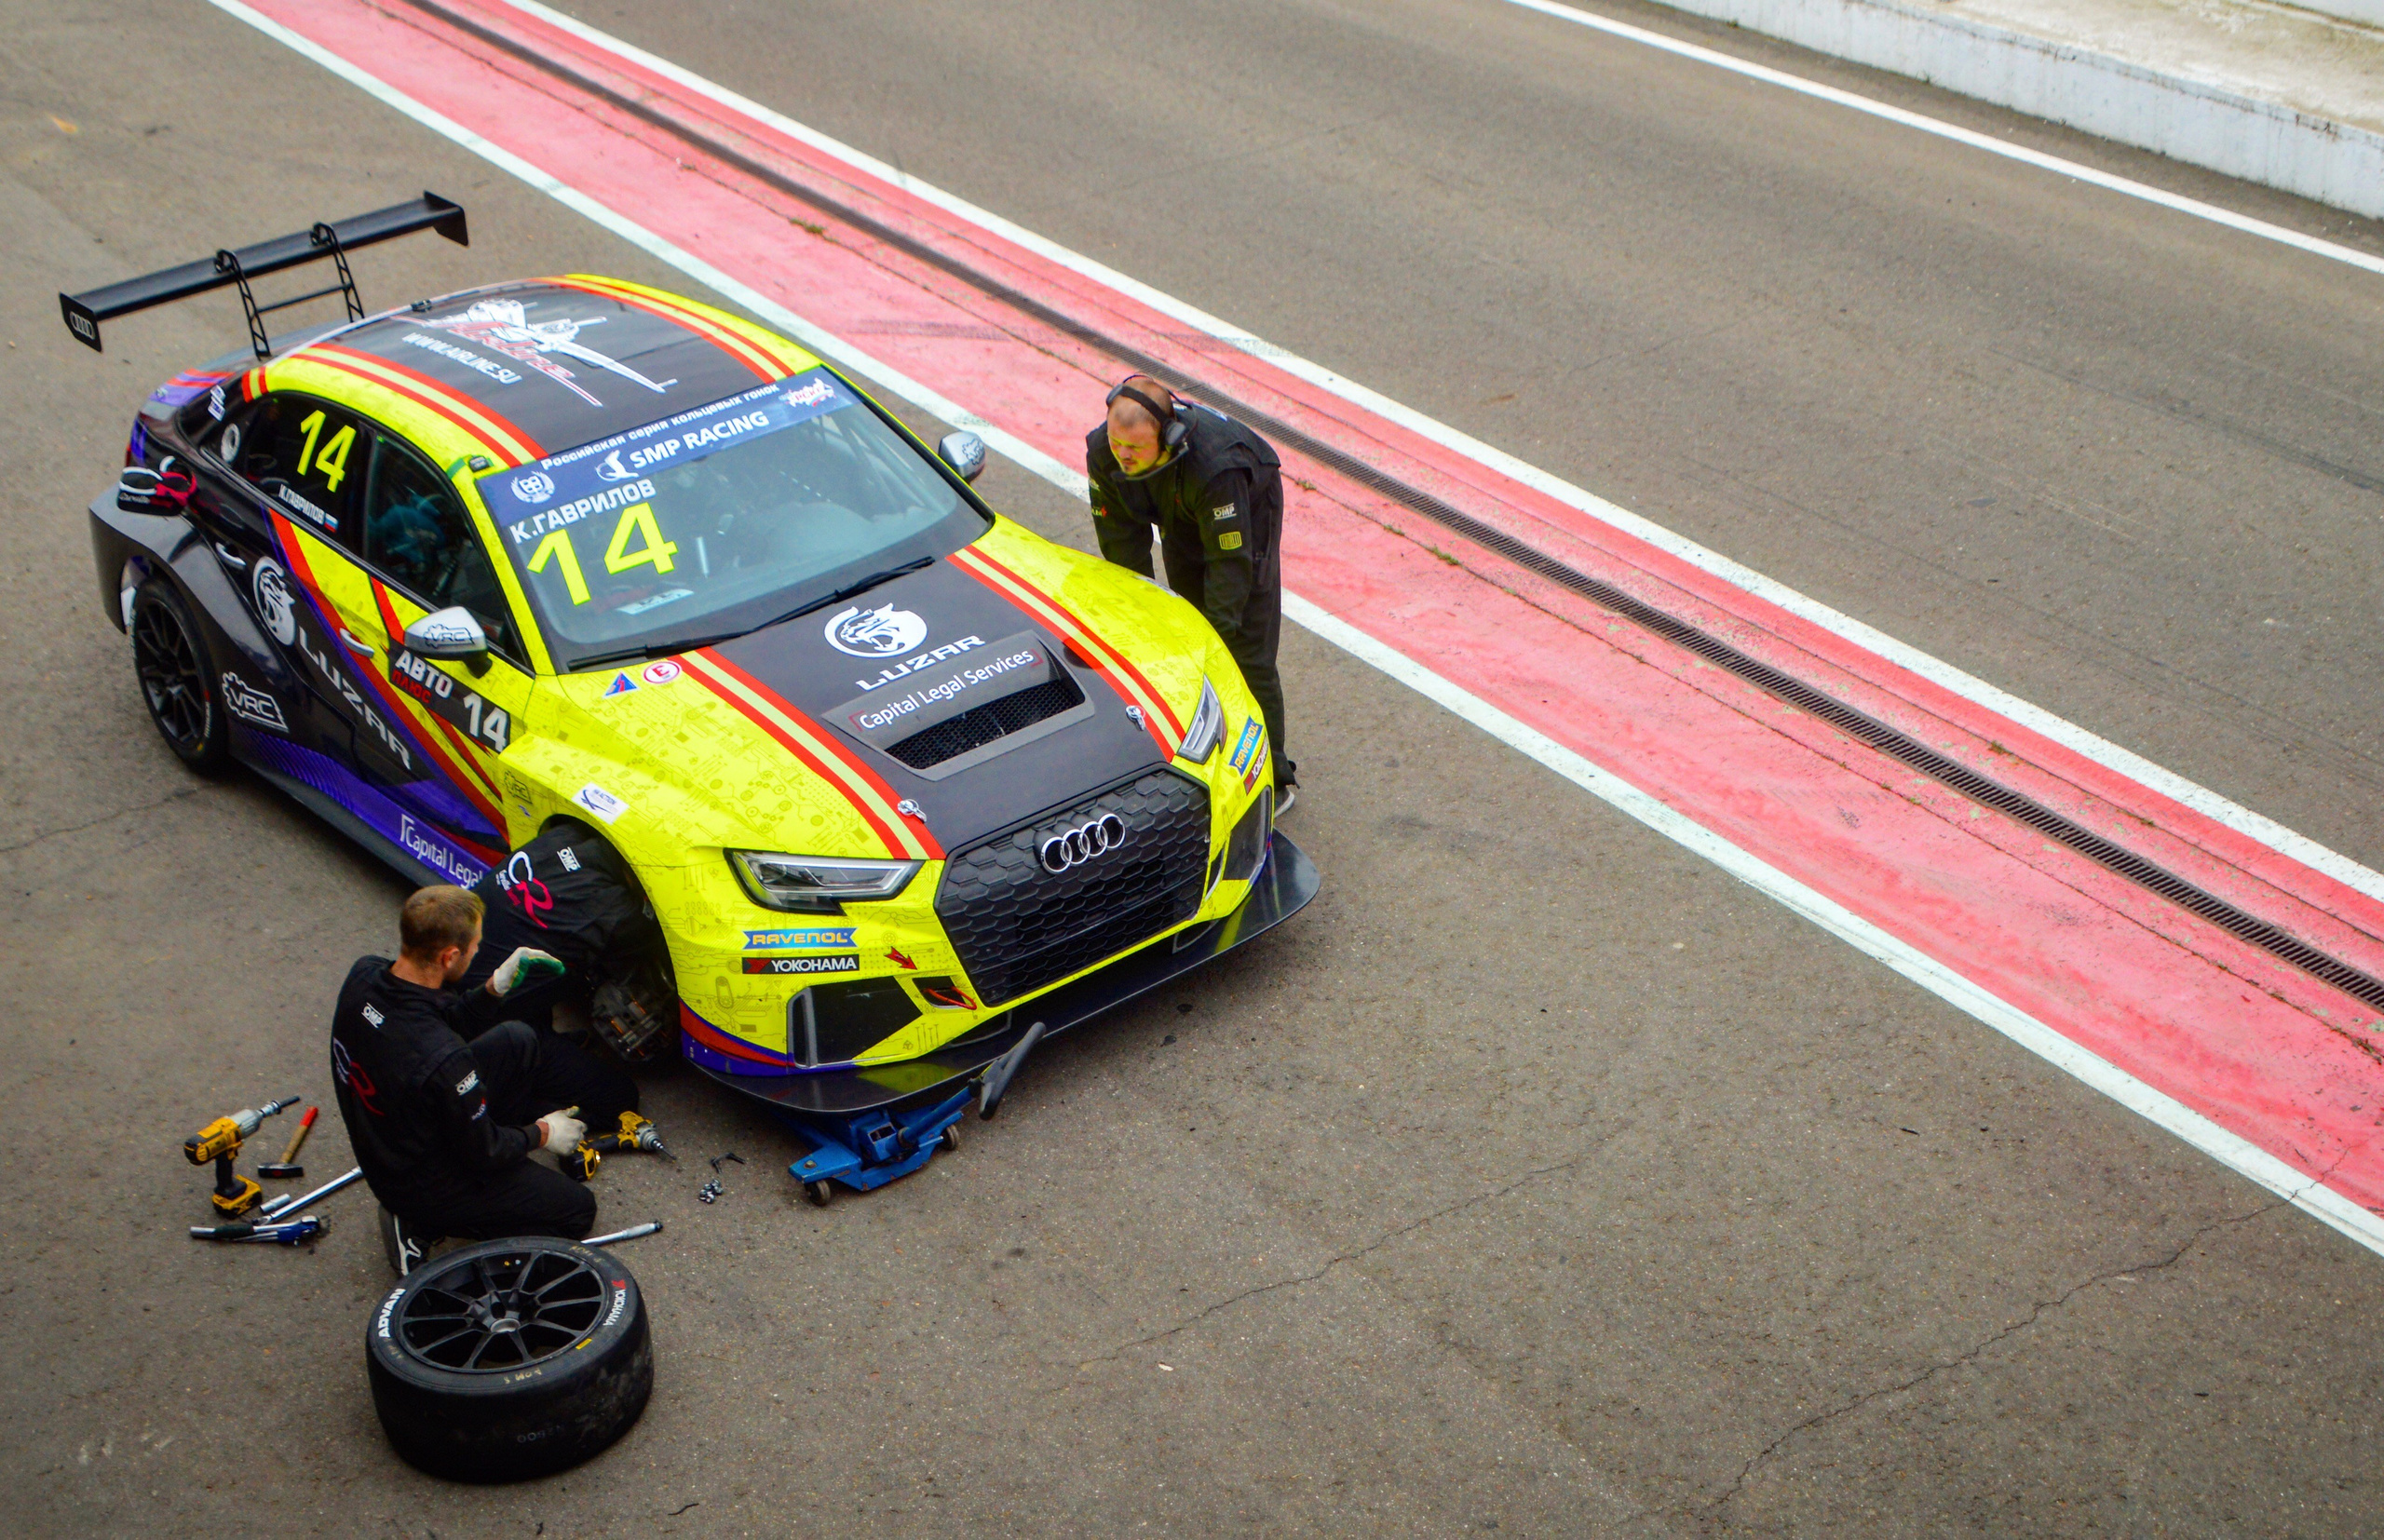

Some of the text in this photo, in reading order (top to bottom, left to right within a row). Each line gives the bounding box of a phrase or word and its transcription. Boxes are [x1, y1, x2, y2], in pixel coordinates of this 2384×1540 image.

[540, 384, 780, 470] Российская серия кольцевых гонок
[630, 411, 770, 469] SMP RACING
[297, 410, 357, 493] 14
[509, 478, 657, 545] К.ГАВРИЛОВ
[1213, 506, 1235, 518] OMP
[527, 502, 678, 606] 14
[430, 632, 467, 642] VRC
[395, 649, 454, 699] АВТО
[652, 665, 670, 678] E
[855, 635, 986, 692] LUZAR
[230, 687, 275, 718] VRC
[298, 625, 412, 771] LUZAR
[391, 669, 431, 704] ПЛЮС
[859, 650, 1035, 729] Capital Legal Services
[463, 692, 508, 753] 14
[1234, 724, 1259, 769] RAVENOL
[405, 825, 447, 870] Capital
[559, 847, 579, 872] OMP
[752, 932, 848, 946] RAVENOL
[771, 957, 858, 973] YOKOHAMA
[362, 1005, 385, 1025] OMP
[455, 1072, 479, 1095] OMP
[377, 1288, 406, 1338] ADVAN
[602, 1289, 627, 1326] YOKOHAMA
